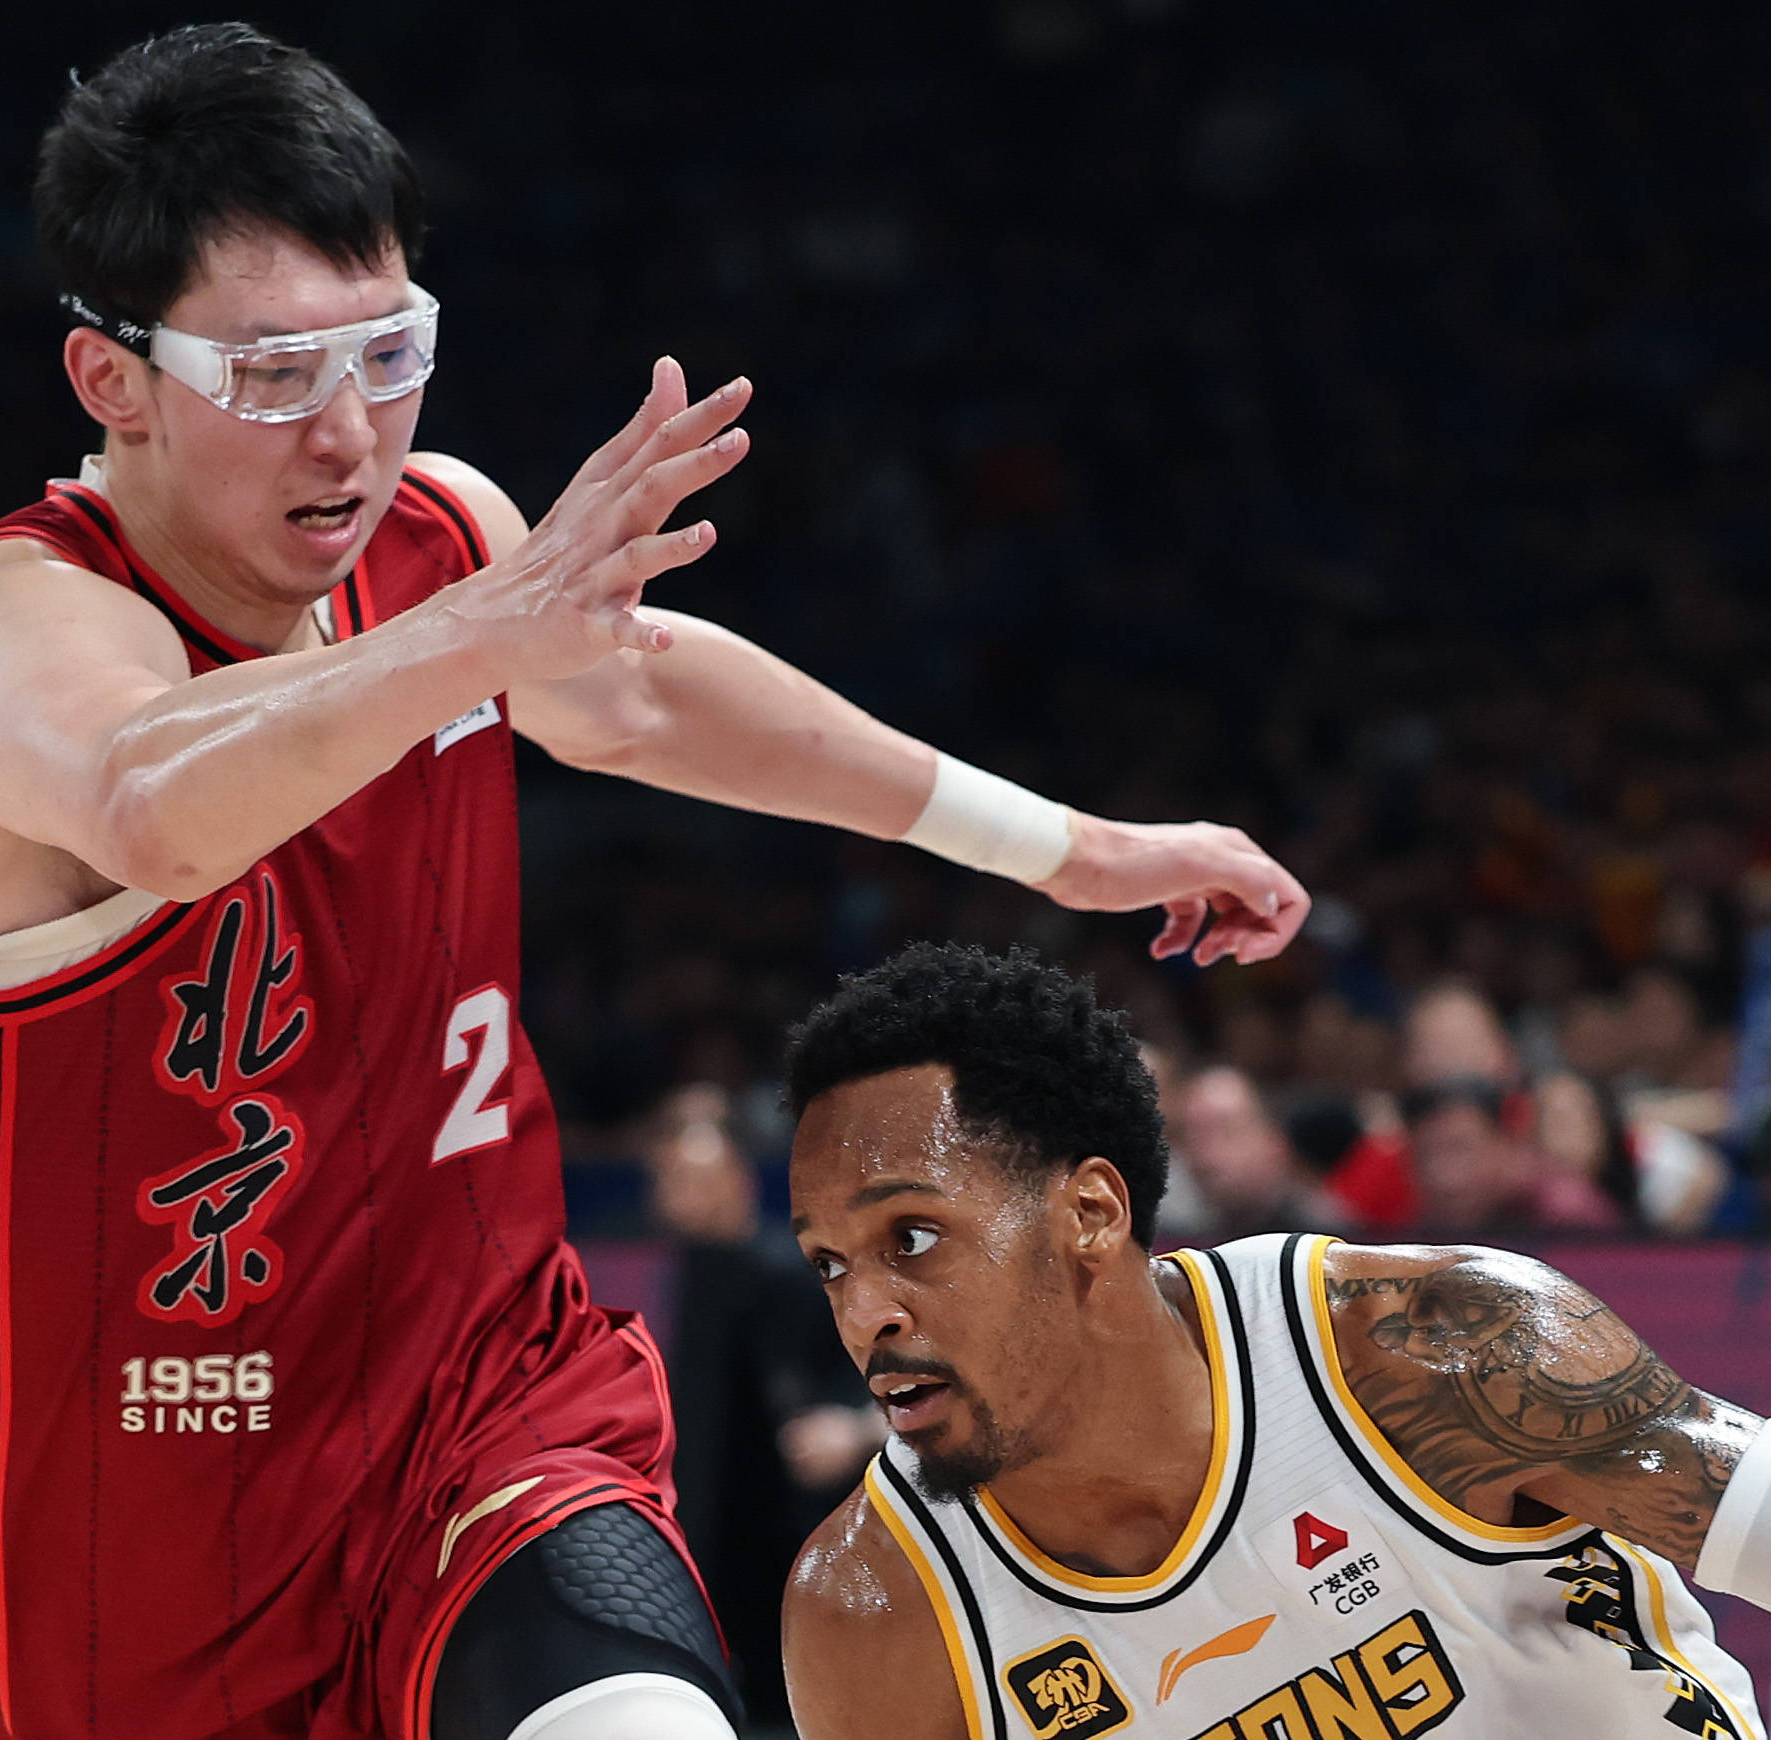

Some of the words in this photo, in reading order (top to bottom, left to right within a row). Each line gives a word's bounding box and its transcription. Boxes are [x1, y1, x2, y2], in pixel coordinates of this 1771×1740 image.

[144, 866, 309, 1317] 北京
[433, 981, 511, 1165] 2
[119, 1351, 274, 1405] 1956
[120, 1404, 272, 1434] SINCE
[1308, 1552, 1381, 1605] 广发银行
[1335, 1579, 1380, 1614] CGB
[1057, 1702, 1111, 1730] CBA
